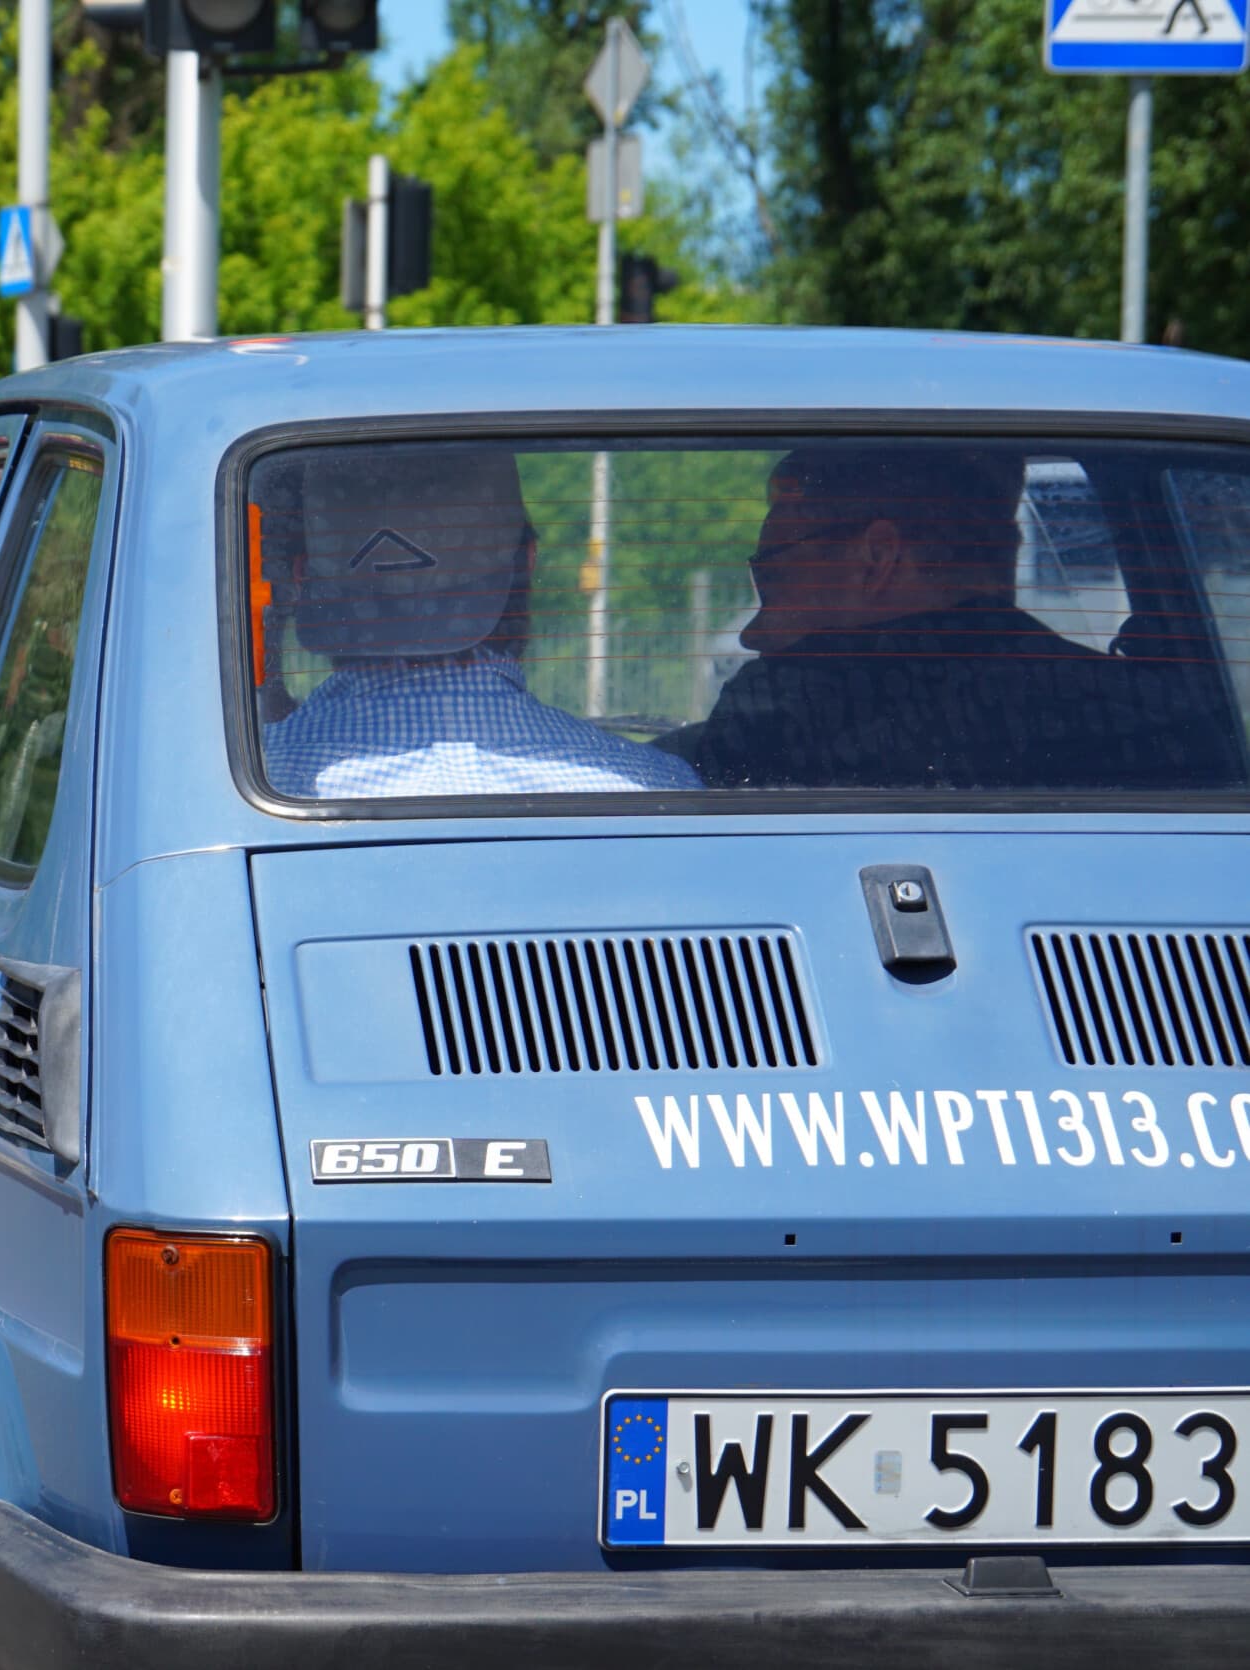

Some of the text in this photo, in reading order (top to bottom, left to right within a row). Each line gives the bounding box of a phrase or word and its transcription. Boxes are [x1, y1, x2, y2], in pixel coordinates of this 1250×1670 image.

[321, 1141, 527, 1176] 650 E
[693, 1409, 1237, 1532] WK 5183
[615, 1489, 657, 1520] PL
